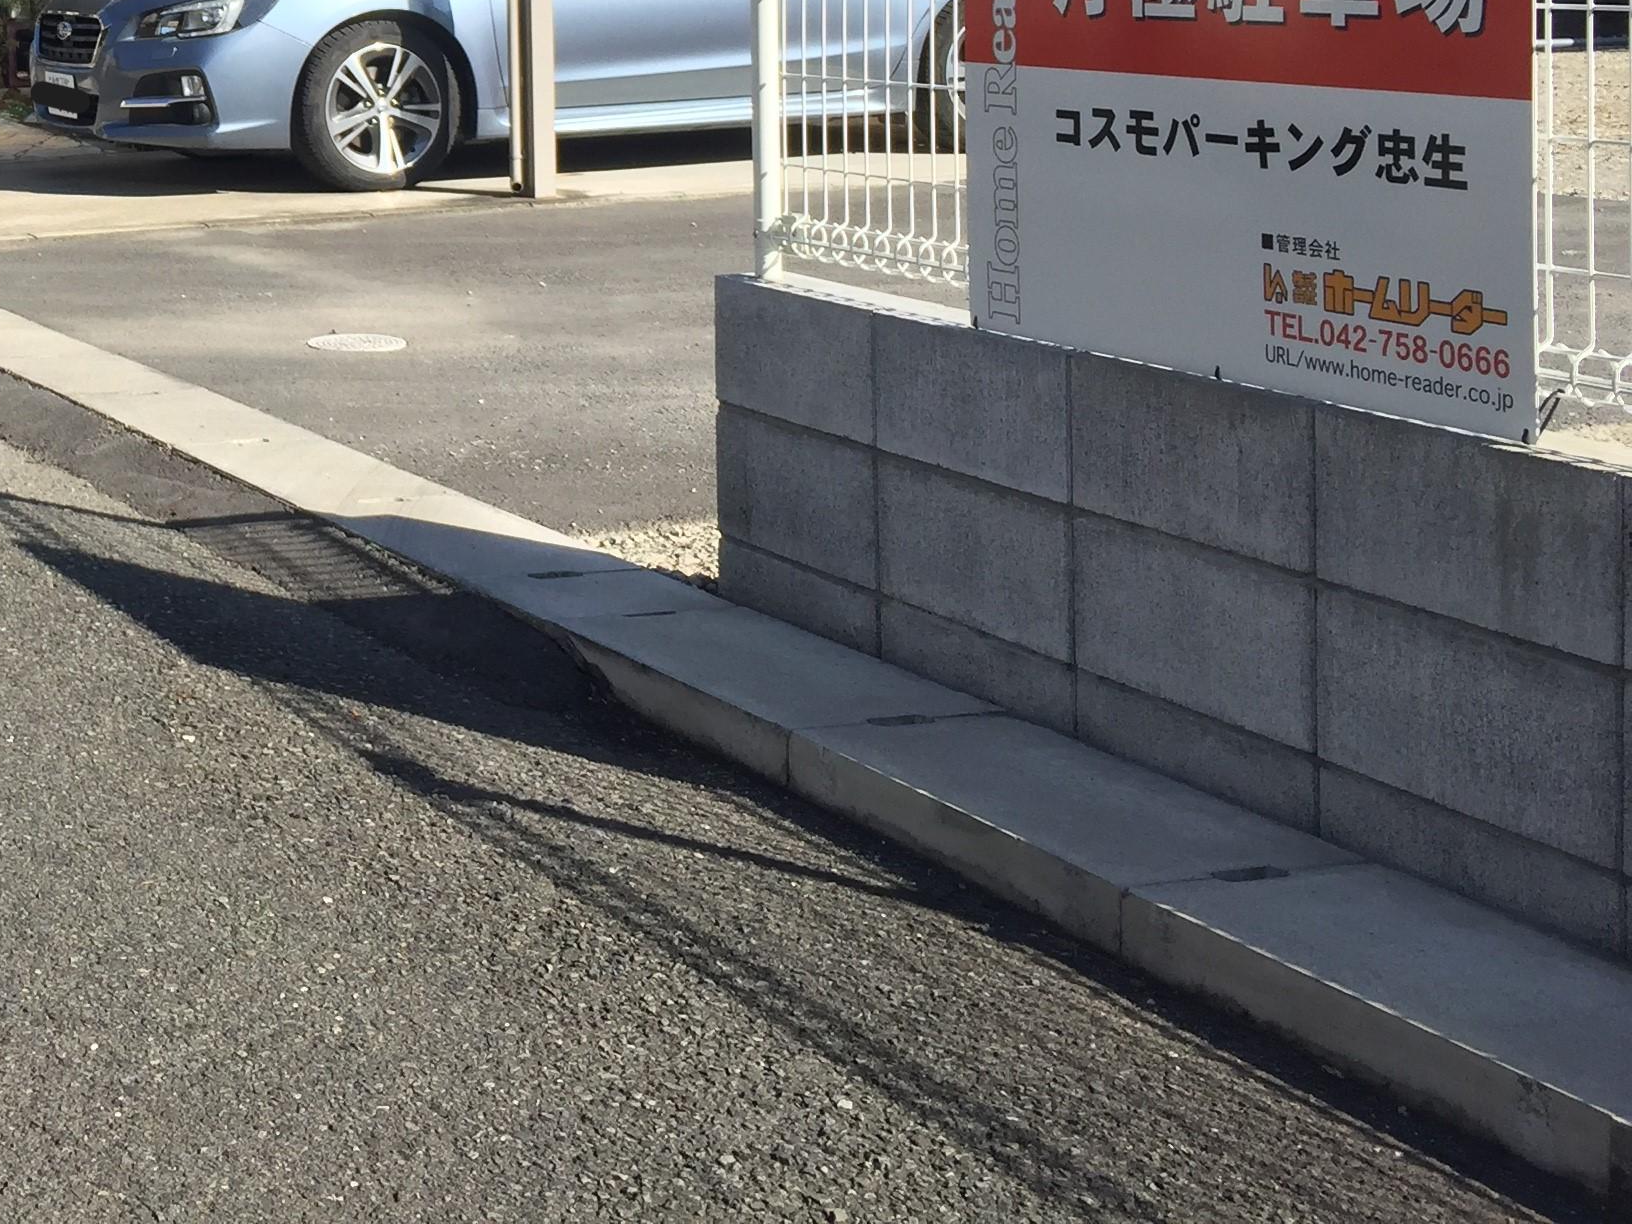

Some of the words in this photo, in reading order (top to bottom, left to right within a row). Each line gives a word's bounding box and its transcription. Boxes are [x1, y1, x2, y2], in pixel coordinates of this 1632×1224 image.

[1055, 108, 1468, 190] コスモパーキング忠生
[986, 127, 1020, 324] Home
